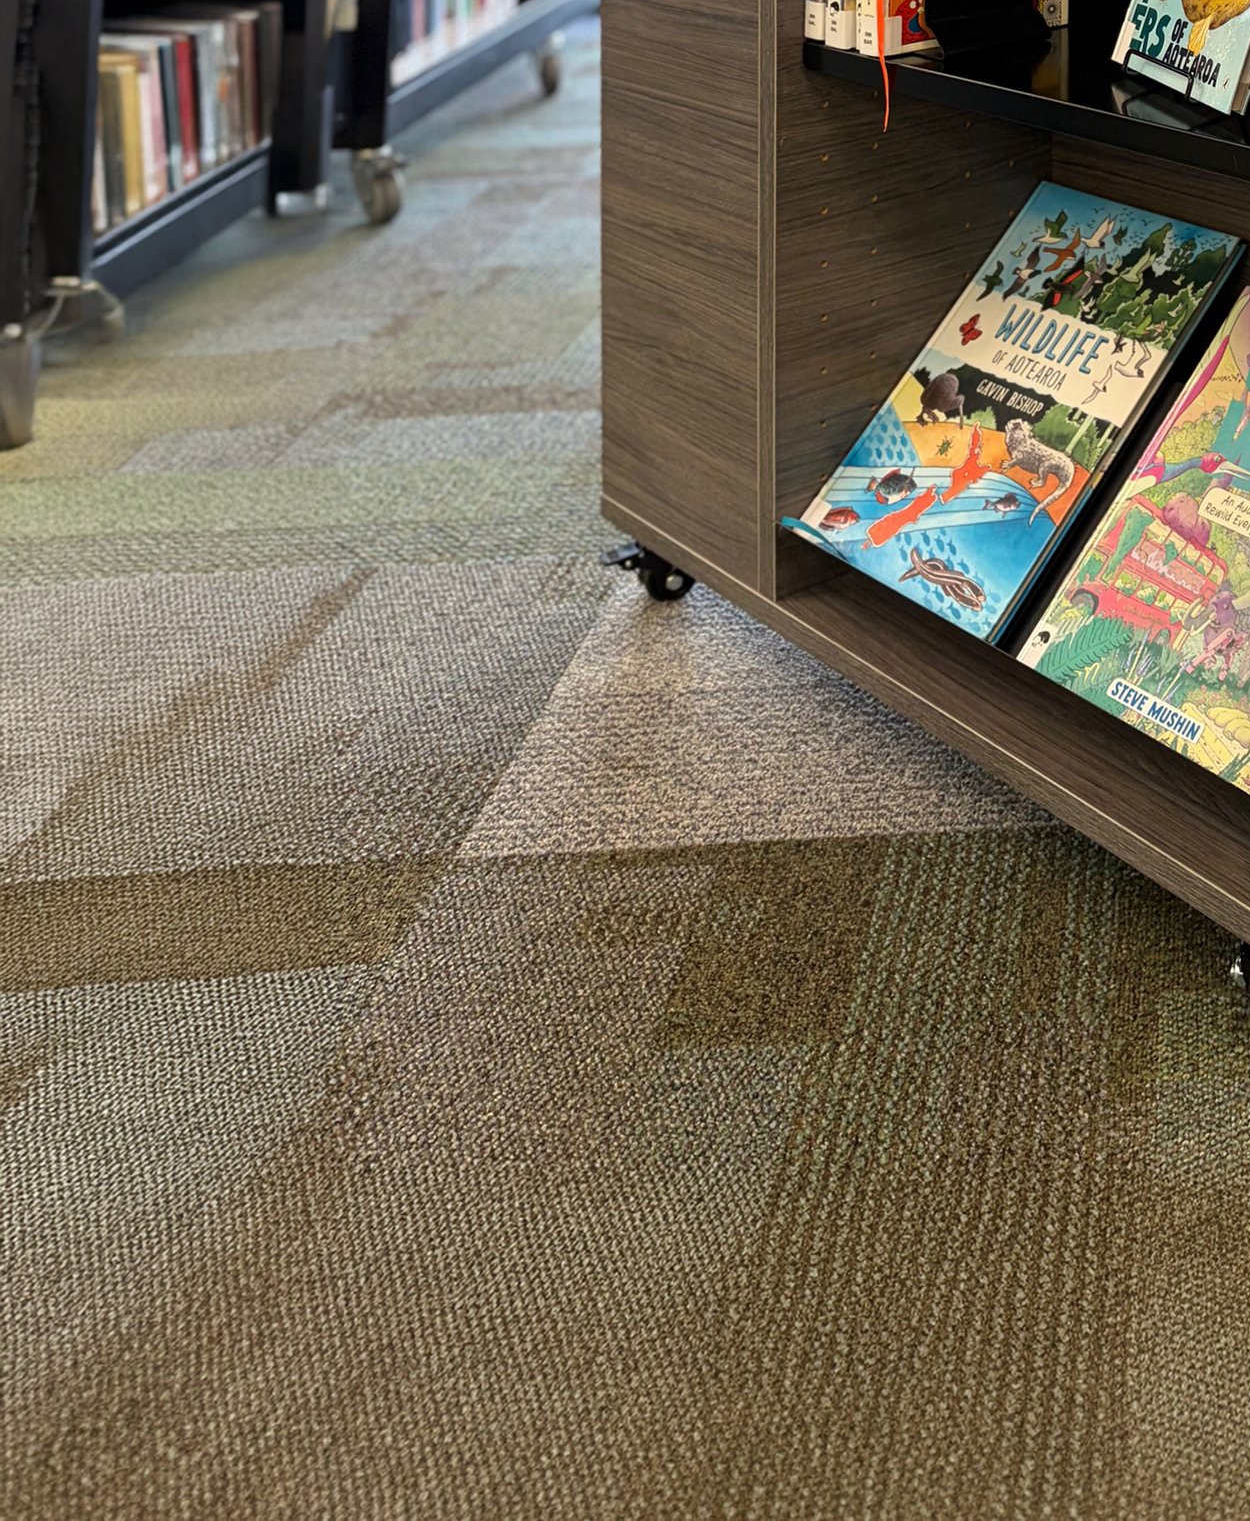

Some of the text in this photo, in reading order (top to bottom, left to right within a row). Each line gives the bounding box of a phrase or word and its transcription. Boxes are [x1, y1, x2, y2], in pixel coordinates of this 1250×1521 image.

[1171, 18, 1189, 43] OF
[1162, 44, 1221, 88] AOTEAROA
[994, 303, 1110, 374] WILDLIFE
[991, 349, 1068, 391] OF AOTEAROA
[976, 378, 1045, 417] GAVIN BISHOP
[1204, 502, 1234, 522] Rewild
[1220, 495, 1235, 507] An
[1110, 681, 1201, 742] STEVE MUSHIN
